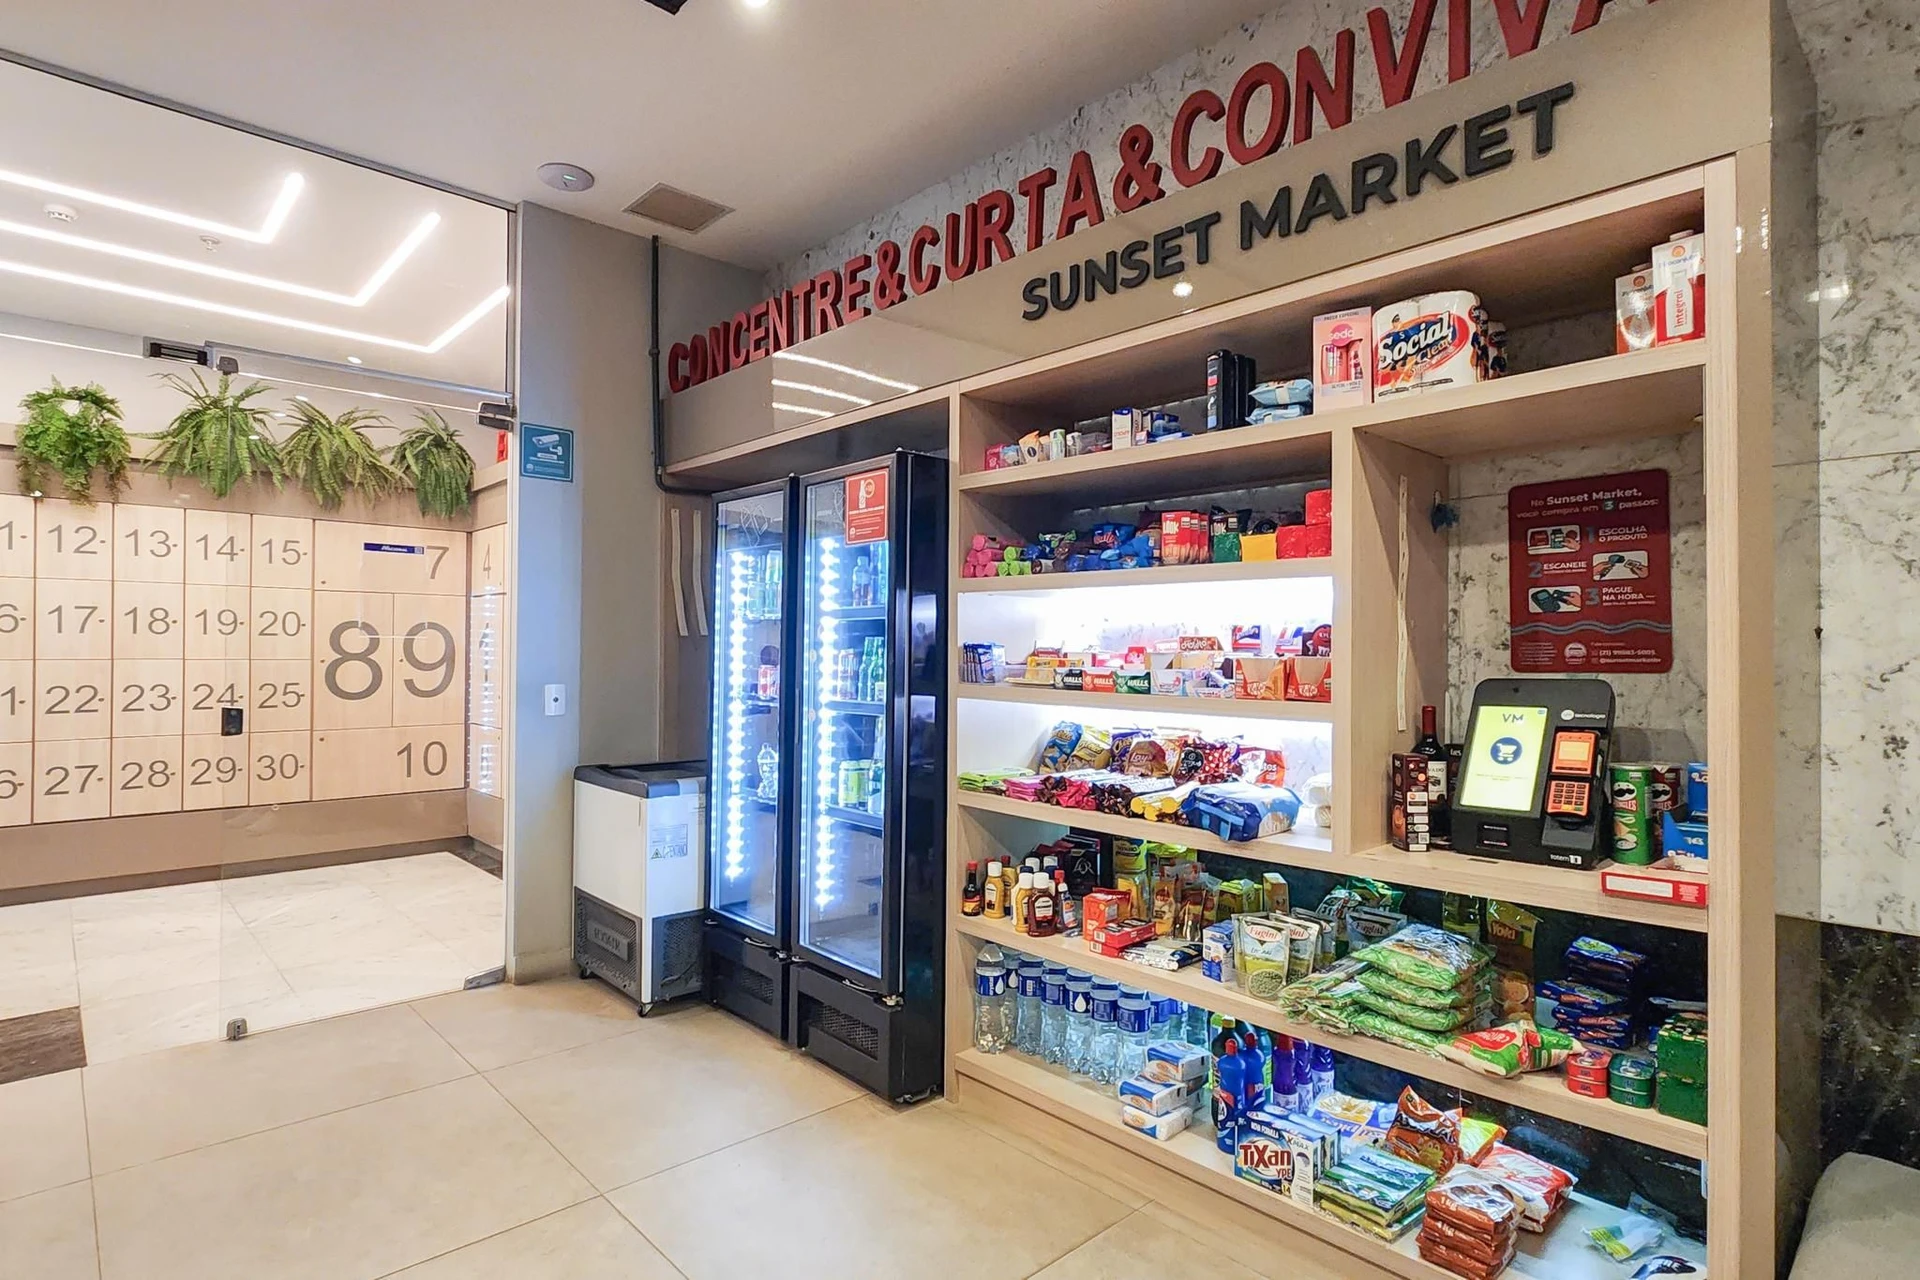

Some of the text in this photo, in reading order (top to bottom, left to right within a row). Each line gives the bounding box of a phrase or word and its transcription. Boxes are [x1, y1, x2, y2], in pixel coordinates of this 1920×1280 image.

[668, 0, 1659, 393] CONCENTRE&CURTA&CONVIV
[1022, 82, 1575, 321] SUNSET MARKET
[1379, 310, 1452, 369] Social
[1546, 494, 1588, 506] Sunset
[1604, 500, 1614, 511] 3
[47, 524, 98, 555] 12
[124, 529, 171, 558] 13
[1598, 525, 1648, 536] ESCOLHA
[1607, 533, 1648, 542] PRODUTO
[195, 533, 239, 562] 14
[260, 538, 301, 565] 15
[425, 545, 450, 580] 7
[1528, 561, 1587, 579] 2 ESCANEIE
[1585, 587, 1600, 606] 3
[1602, 586, 1634, 594] PAGUE
[1602, 593, 1644, 602] NA HORA
[47, 605, 98, 634] 17
[124, 606, 170, 635] 18
[194, 609, 238, 636] 19
[258, 611, 301, 636] 20
[324, 620, 383, 701] 8
[402, 621, 456, 698] 9
[191, 683, 239, 711] 24
[257, 682, 301, 709] 25
[1127, 679, 1149, 688] HALLS
[45, 685, 99, 715] 22
[121, 683, 171, 713] 23
[1502, 713, 1524, 723] VM
[190, 756, 237, 786] 29
[256, 753, 299, 781] 30
[396, 741, 447, 778] 10
[43, 764, 99, 796] 27
[120, 760, 171, 791] 28
[1289, 927, 1305, 938] gini
